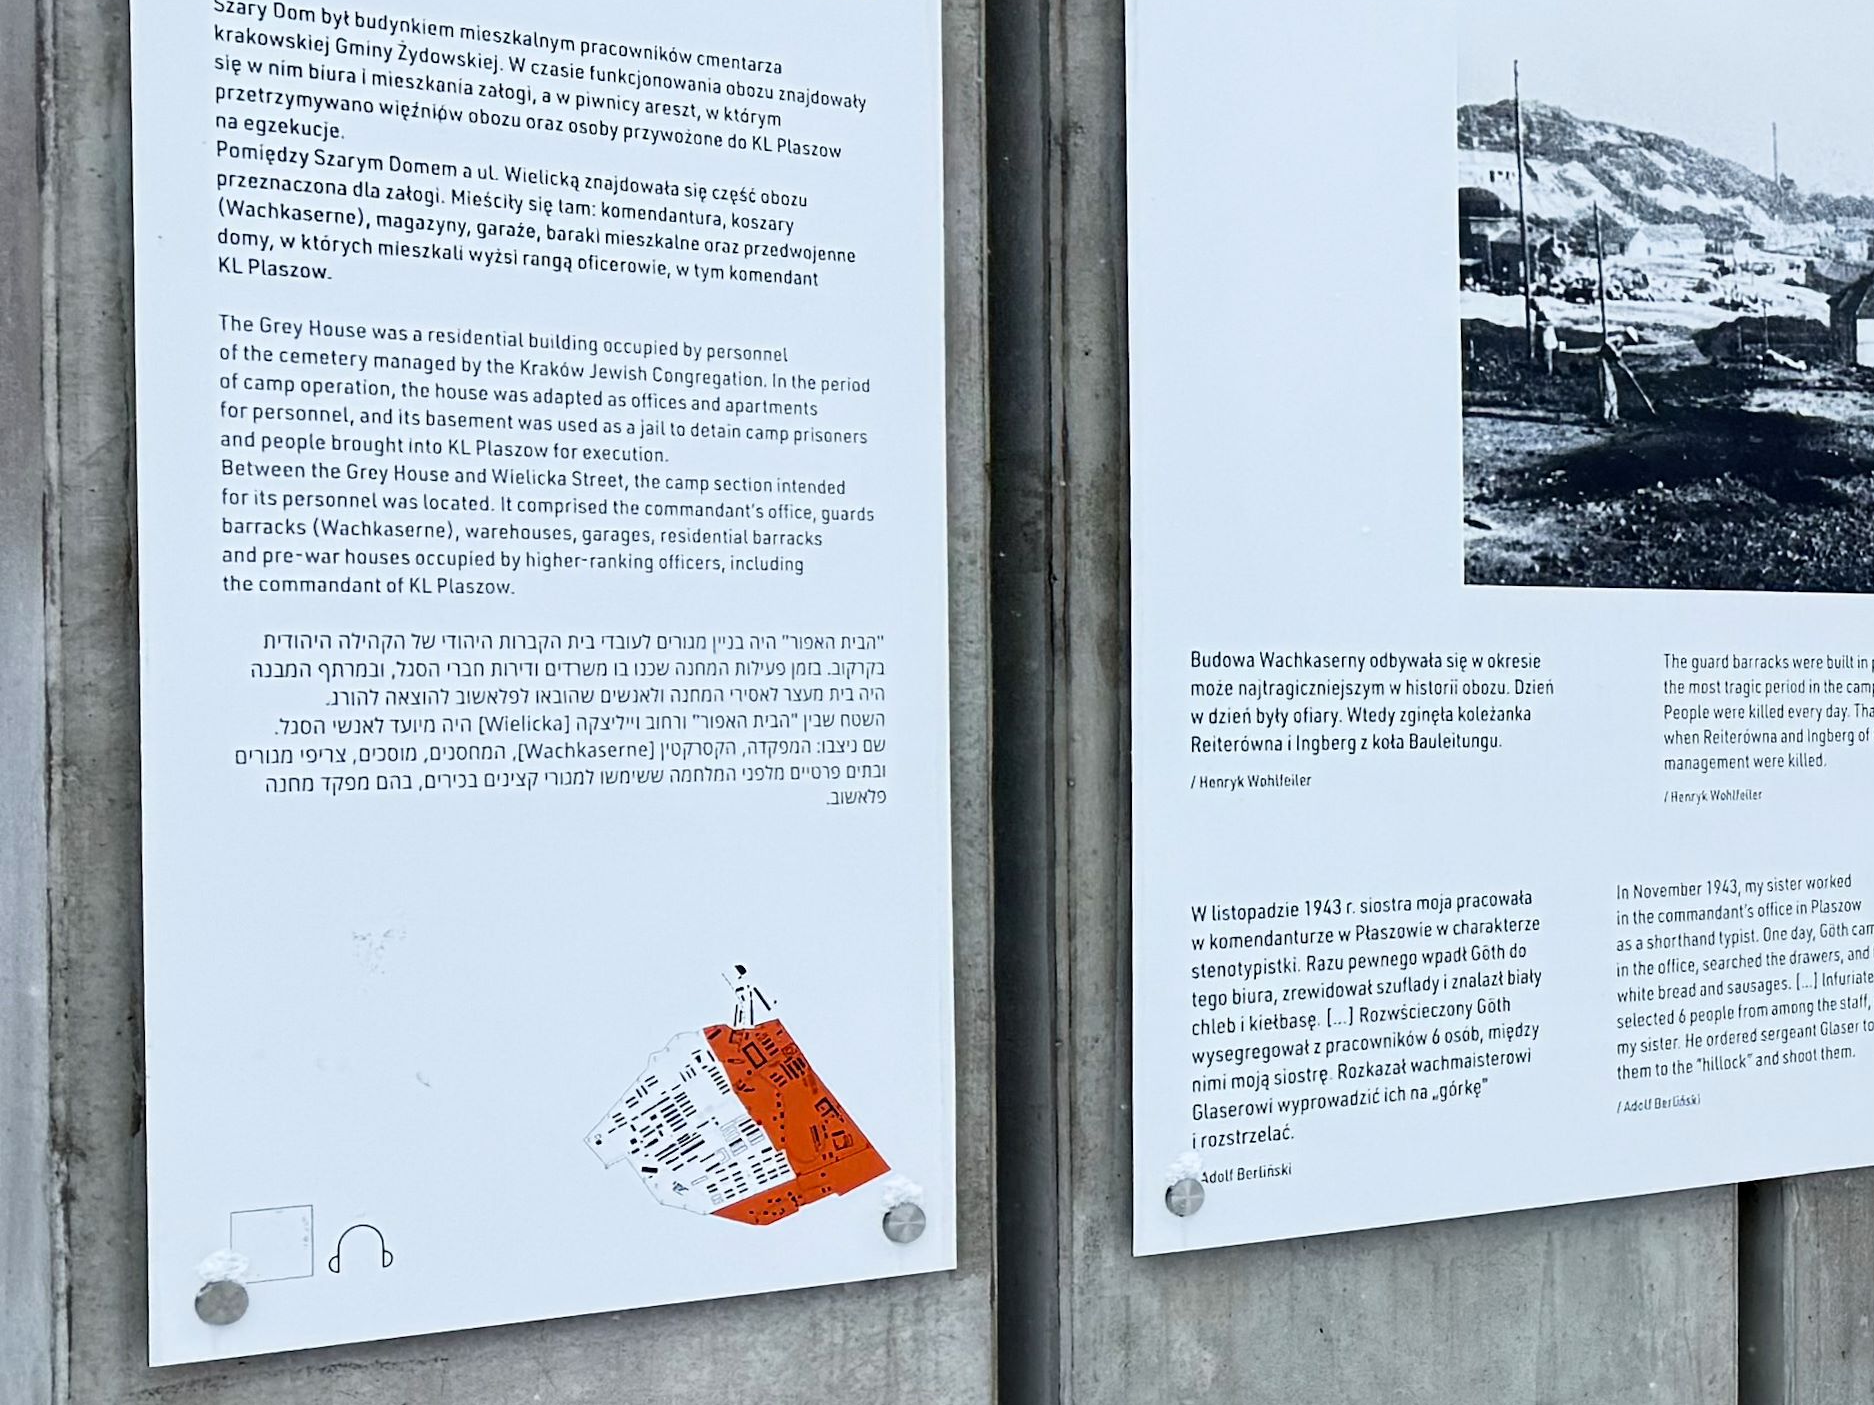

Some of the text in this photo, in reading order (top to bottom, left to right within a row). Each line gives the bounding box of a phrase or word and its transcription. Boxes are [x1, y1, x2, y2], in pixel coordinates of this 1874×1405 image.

[272, 1, 315, 23] Dom
[320, 6, 350, 30] był
[354, 10, 454, 38] budynkiem
[459, 24, 575, 54] mieszkalnym
[579, 40, 692, 64] pracowników
[695, 53, 782, 75] cmentarza
[213, 23, 867, 114] krakowskiej Gminy Żydowskiej. W czasie funkcjonowania obozu znajdowały
[215, 85, 842, 158] przetrzymywano więźniów obozu oraz osoby przywożone do KL Plaszow
[218, 313, 788, 362] The Grey House was a residential building occupied by personnel
[219, 342, 870, 395] of the cemetery managed by the Kraków Jewish Congregation. In the period
[221, 545, 804, 576] and pre-war houses occupied by higher-ranking officers, including
[263, 633, 332, 650] היהודית
[338, 631, 405, 655] הקהילה
[410, 632, 436, 650] של
[441, 634, 493, 650] היהודי
[498, 634, 562, 655] הקברות
[567, 634, 596, 650] בית
[600, 633, 651, 650] לעובדי
[656, 634, 707, 650] מגורים
[711, 634, 744, 654] בניין
[749, 635, 777, 650] היה
[1190, 649, 1541, 674] Budowa Wachkaserny odbywała się w okresie
[1663, 652, 1688, 669] The
[1690, 653, 1729, 674] guard
[1731, 653, 1790, 669] barracks
[1791, 657, 1824, 670] were
[1826, 653, 1854, 670] built
[1856, 657, 1868, 669] in
[1190, 677, 1554, 701] może najtragiczniejszym w historii obozu. Dzień
[1663, 678, 1685, 695] the
[1688, 679, 1721, 694] most
[1724, 678, 1762, 699] tragic
[1764, 679, 1805, 698] period
[1808, 678, 1820, 694] in
[1823, 678, 1843, 694] the
[1190, 731, 1502, 756] Reiterówna i Ingberg z koła Bauleitungu.
[825, 788, 887, 806] פלאשוב.
[1616, 873, 1852, 900] In November 1943, my sister worked
[1190, 888, 1533, 925] W listopadzie 1943 r. siostra moja pracowała
[1616, 909, 1629, 926] in
[1632, 909, 1655, 925] the
[1756, 900, 1793, 918] office
[1795, 903, 1808, 915] in
[1810, 898, 1862, 914] Plaszow
[1190, 916, 1540, 951] w komendanturze w Płaszowie w charakterze
